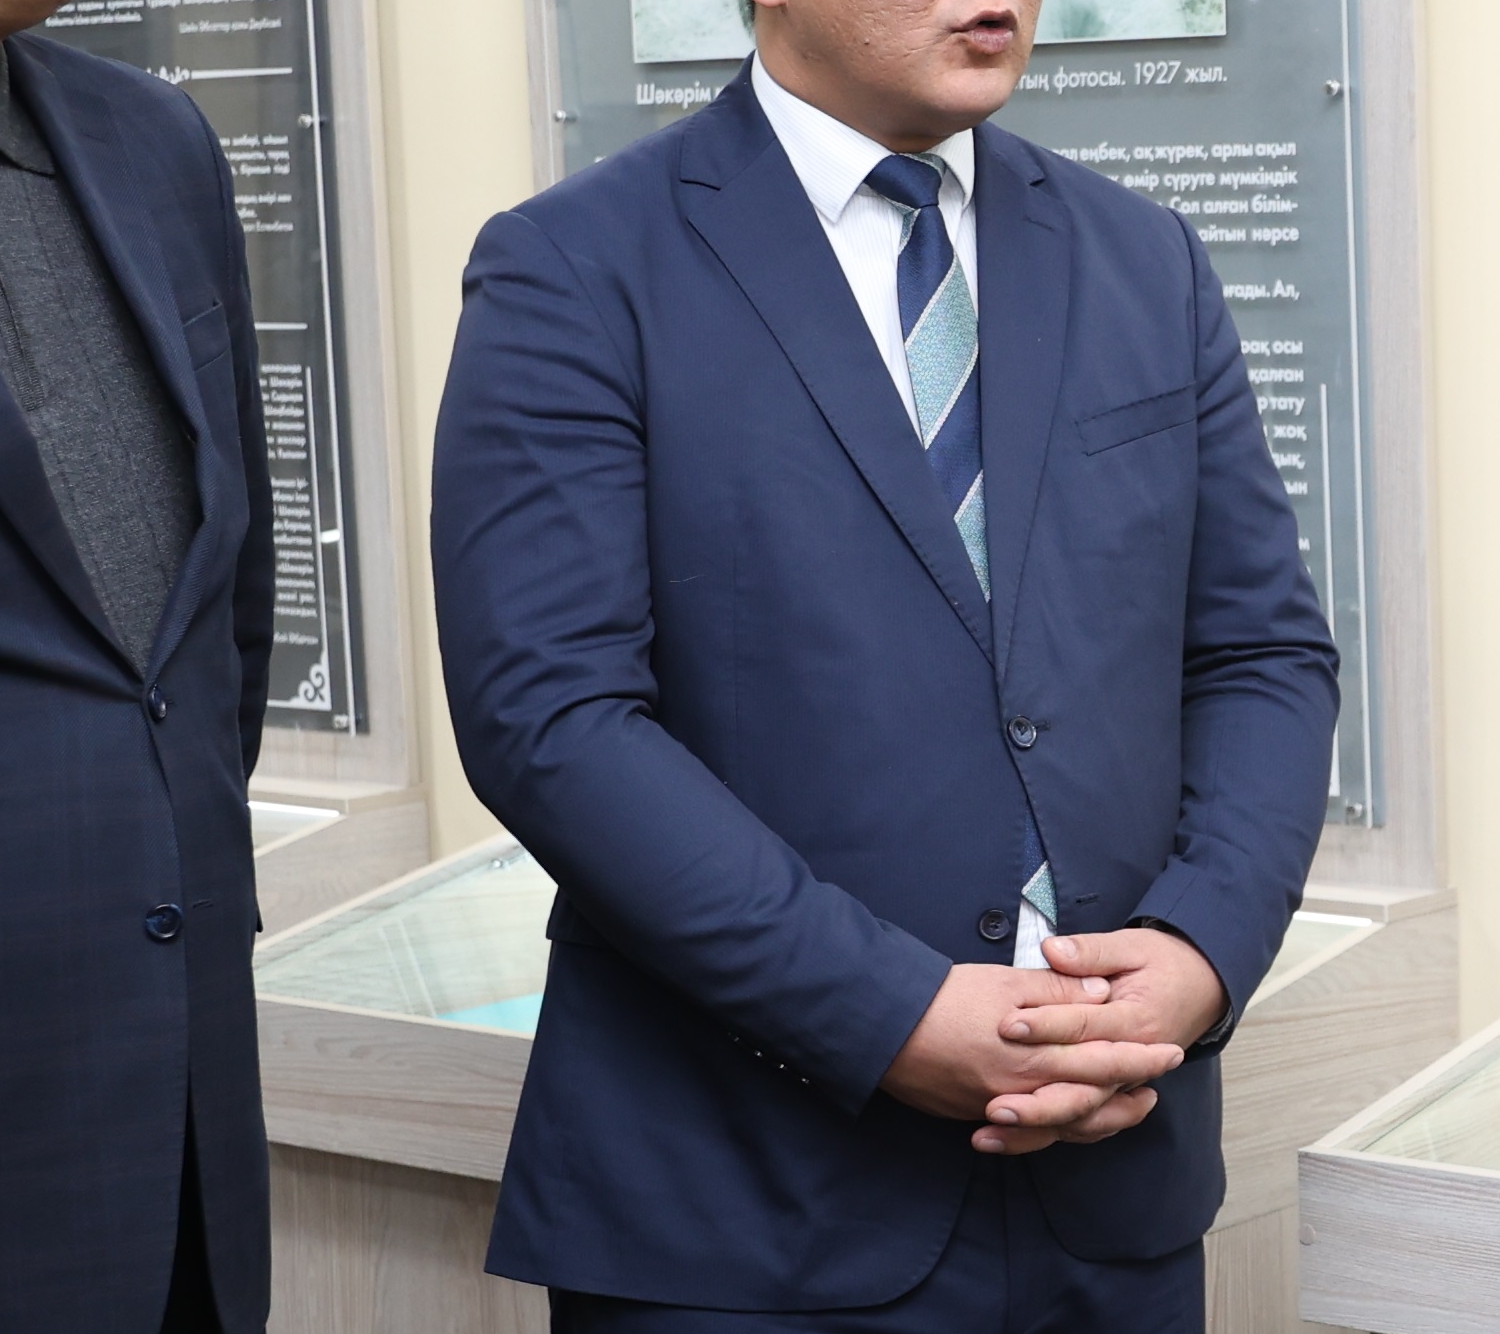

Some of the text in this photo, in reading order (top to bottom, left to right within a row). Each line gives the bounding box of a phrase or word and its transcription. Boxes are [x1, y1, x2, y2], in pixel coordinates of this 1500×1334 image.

[1053, 61, 1228, 94] фотосы. 1927 жыл.
[636, 81, 711, 109] Шәкәрім
[1080, 143, 1131, 162] еңбек,
[1254, 142, 1297, 160] ақыл
[1123, 166, 1298, 193] өмір сүруге мүмкіндік
[1203, 199, 1249, 214] алған
[1251, 227, 1299, 245] нәрсе
[1273, 279, 1301, 301] Ал,
